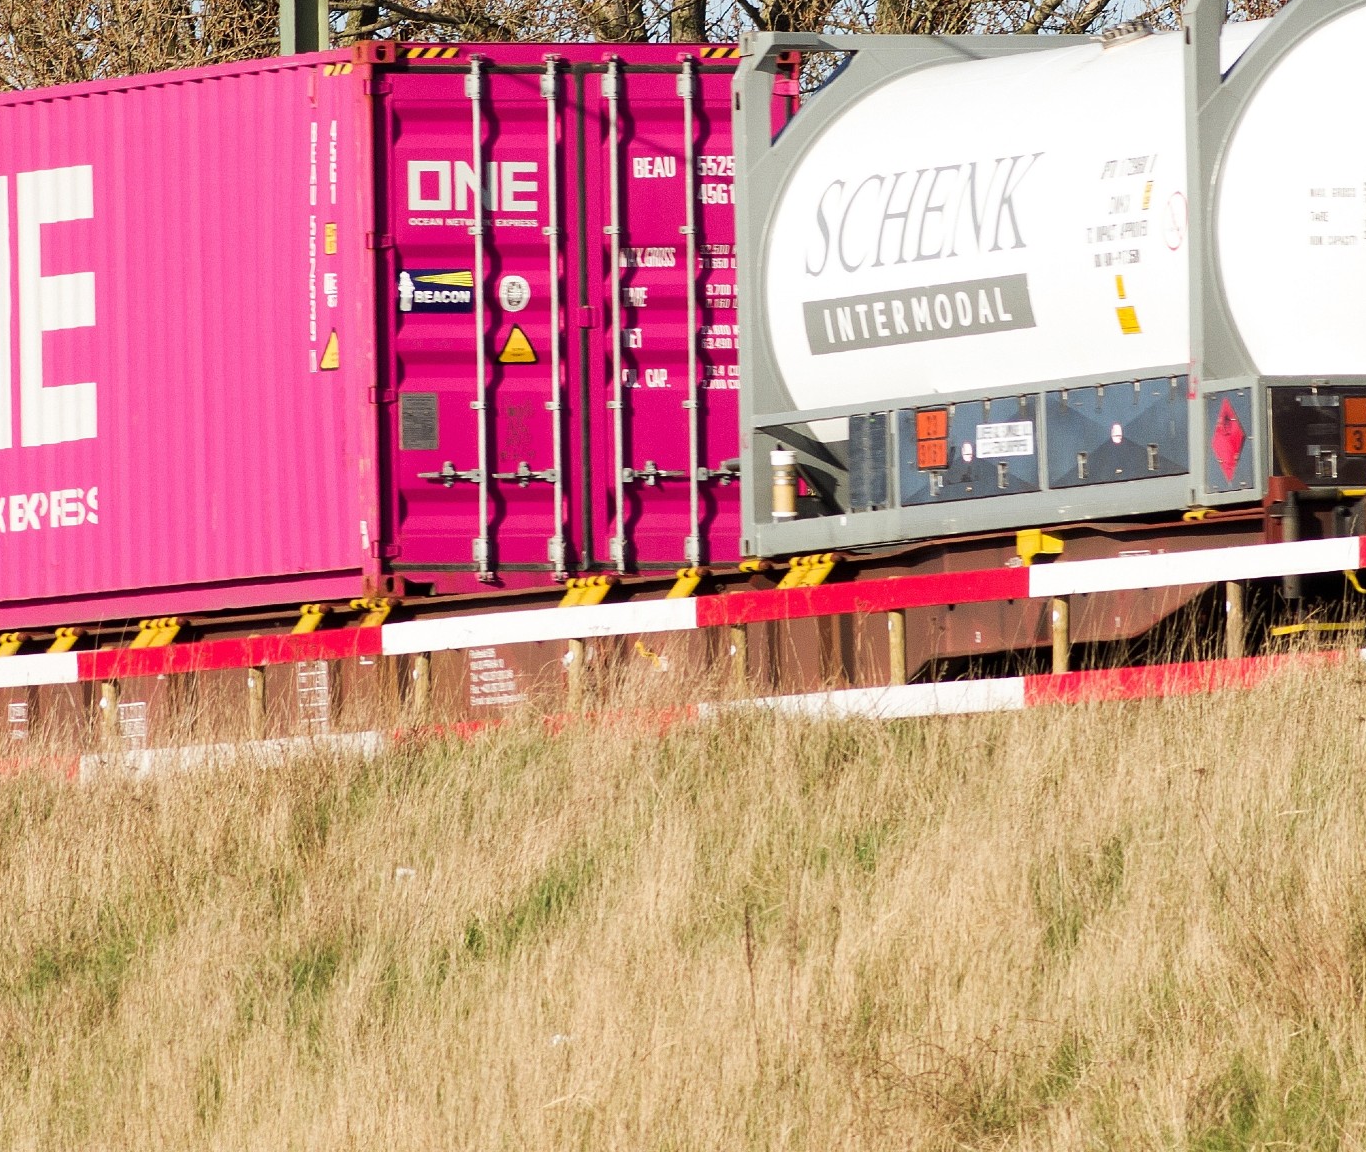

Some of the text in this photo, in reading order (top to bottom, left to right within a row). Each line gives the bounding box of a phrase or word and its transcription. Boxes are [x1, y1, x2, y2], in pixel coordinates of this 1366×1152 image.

[633, 156, 677, 178] BEAU
[407, 160, 539, 212] ONE
[408, 217, 444, 227] OCEAN
[805, 151, 1046, 277] SCHENK
[414, 290, 471, 303] BEACON
[823, 286, 1014, 344] INTERMODAL
